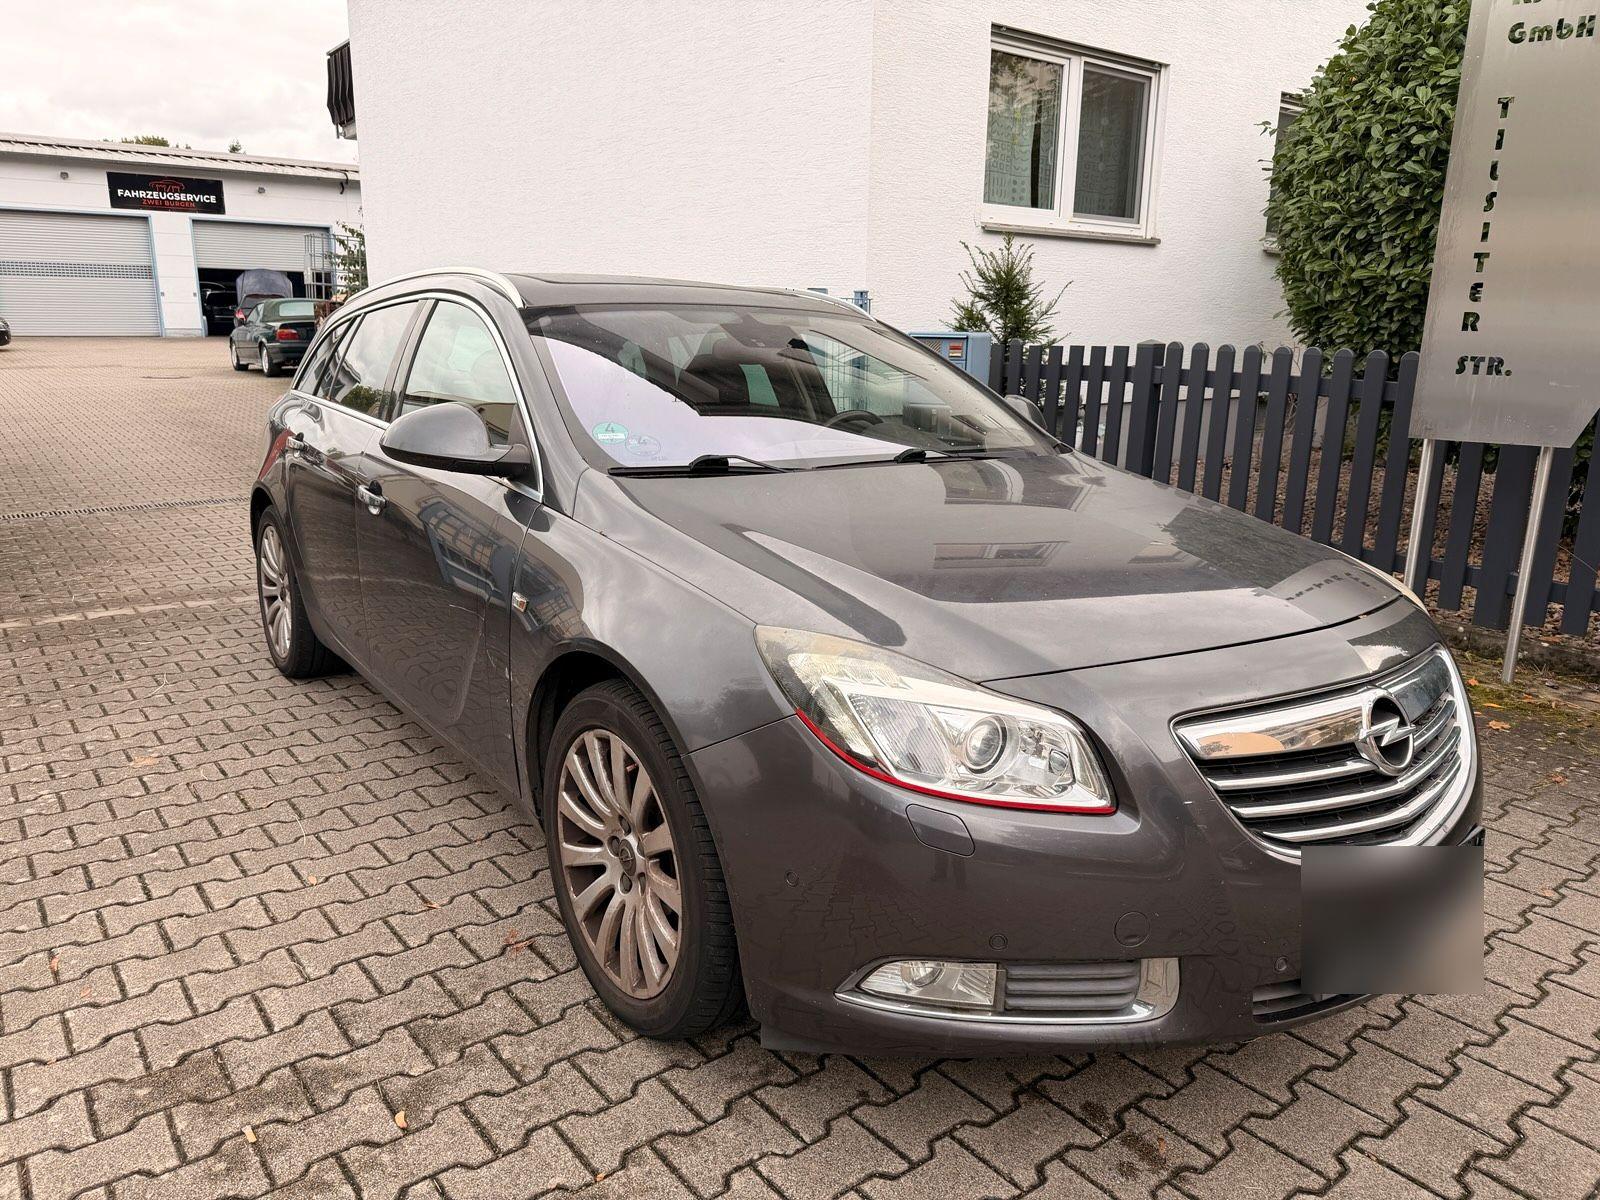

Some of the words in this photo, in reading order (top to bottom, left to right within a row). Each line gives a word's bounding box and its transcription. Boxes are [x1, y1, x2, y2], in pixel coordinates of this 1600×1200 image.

[1508, 15, 1597, 44] GmbH
[117, 189, 217, 203] FAHRZEUGSERVICE
[142, 199, 163, 207] ZWEI
[164, 200, 196, 208] BURGEN
[1461, 96, 1515, 331] TILSITER
[1455, 356, 1512, 376] STR.
[605, 422, 616, 433] 4
